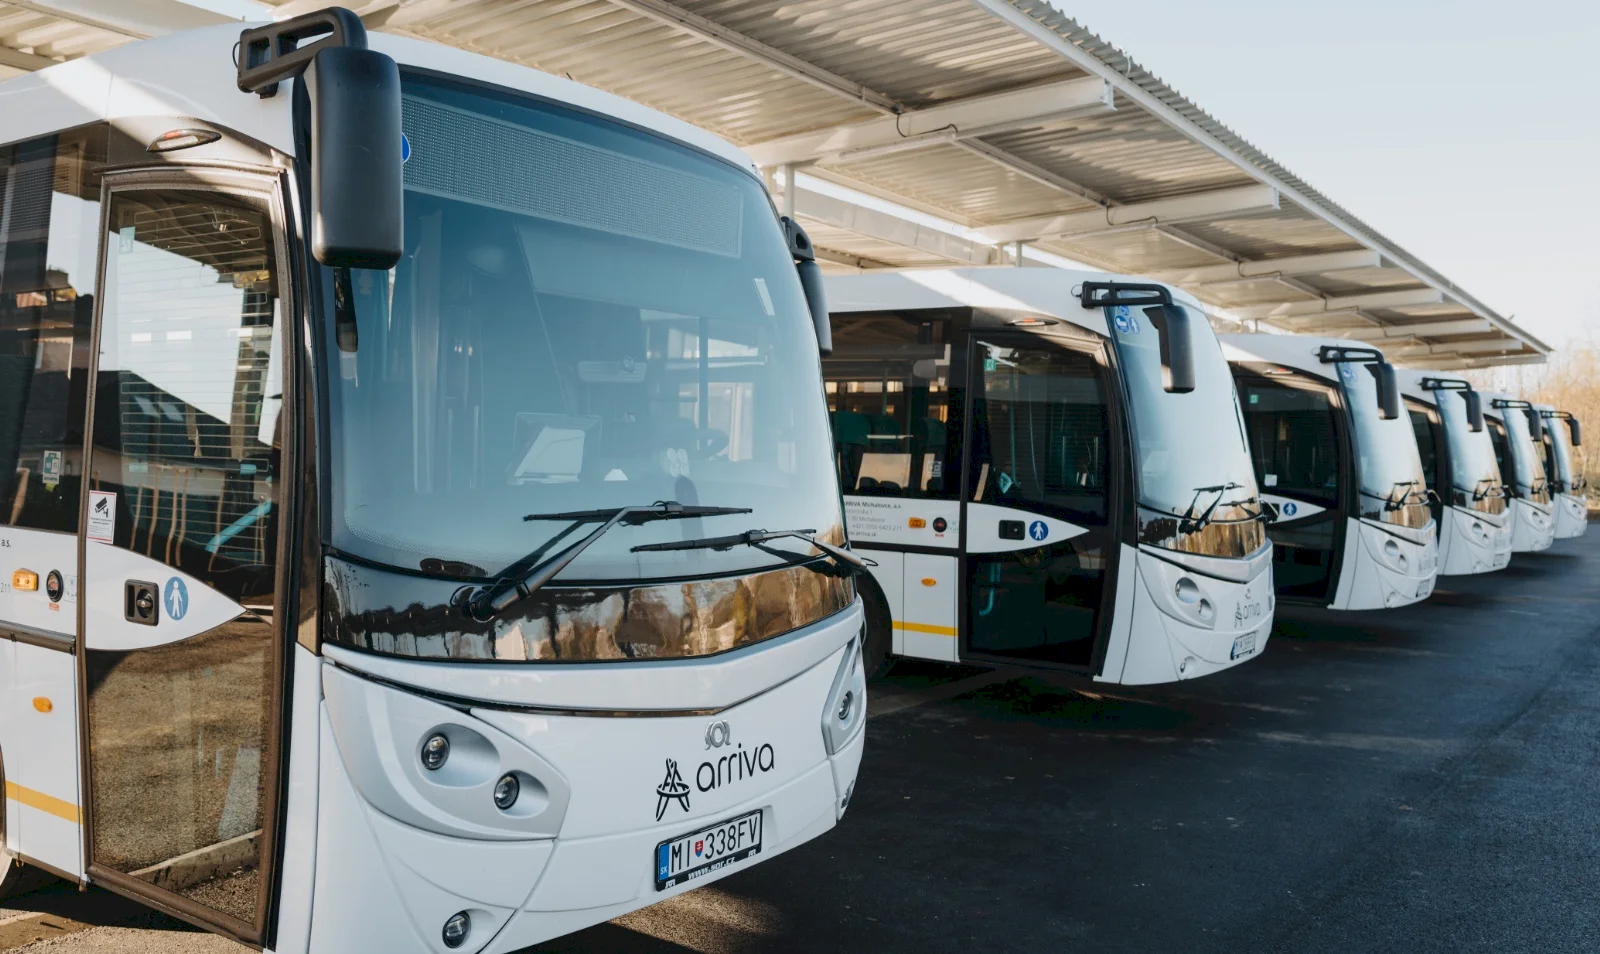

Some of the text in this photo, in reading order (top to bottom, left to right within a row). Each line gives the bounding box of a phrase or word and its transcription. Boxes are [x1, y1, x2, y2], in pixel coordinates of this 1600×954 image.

[1, 539, 12, 548] a.s.
[696, 742, 775, 793] arriva
[660, 816, 758, 876] SK MI 338FV
[688, 856, 736, 881] www.sor.cz
